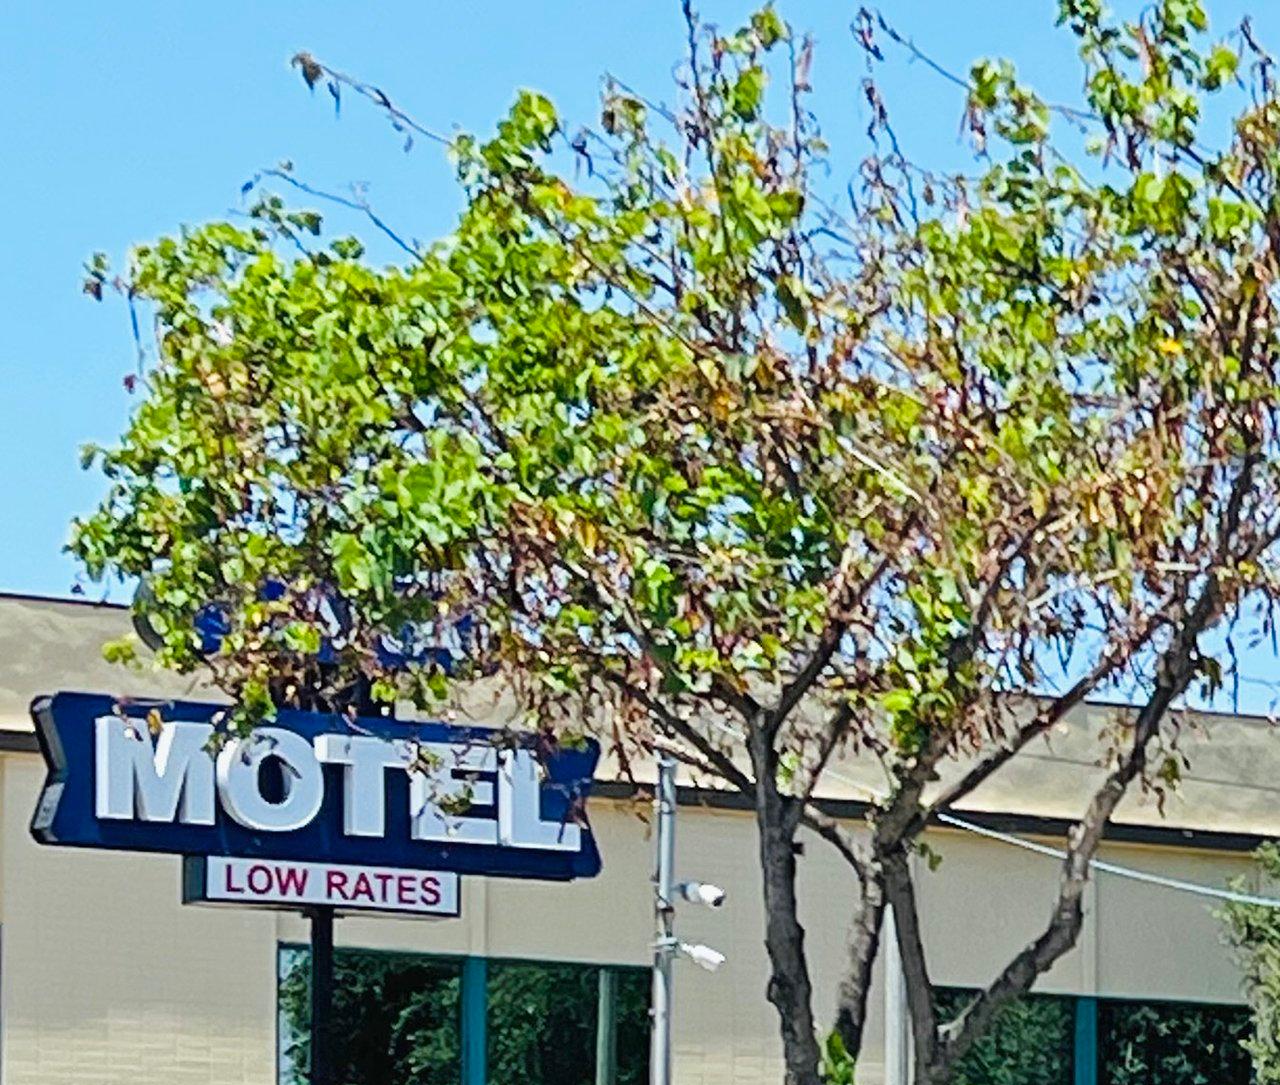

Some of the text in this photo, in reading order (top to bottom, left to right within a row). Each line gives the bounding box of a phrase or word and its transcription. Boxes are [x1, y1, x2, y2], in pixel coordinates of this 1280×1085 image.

[95, 715, 582, 852] MOTEL
[225, 864, 442, 906] LOW RATES
